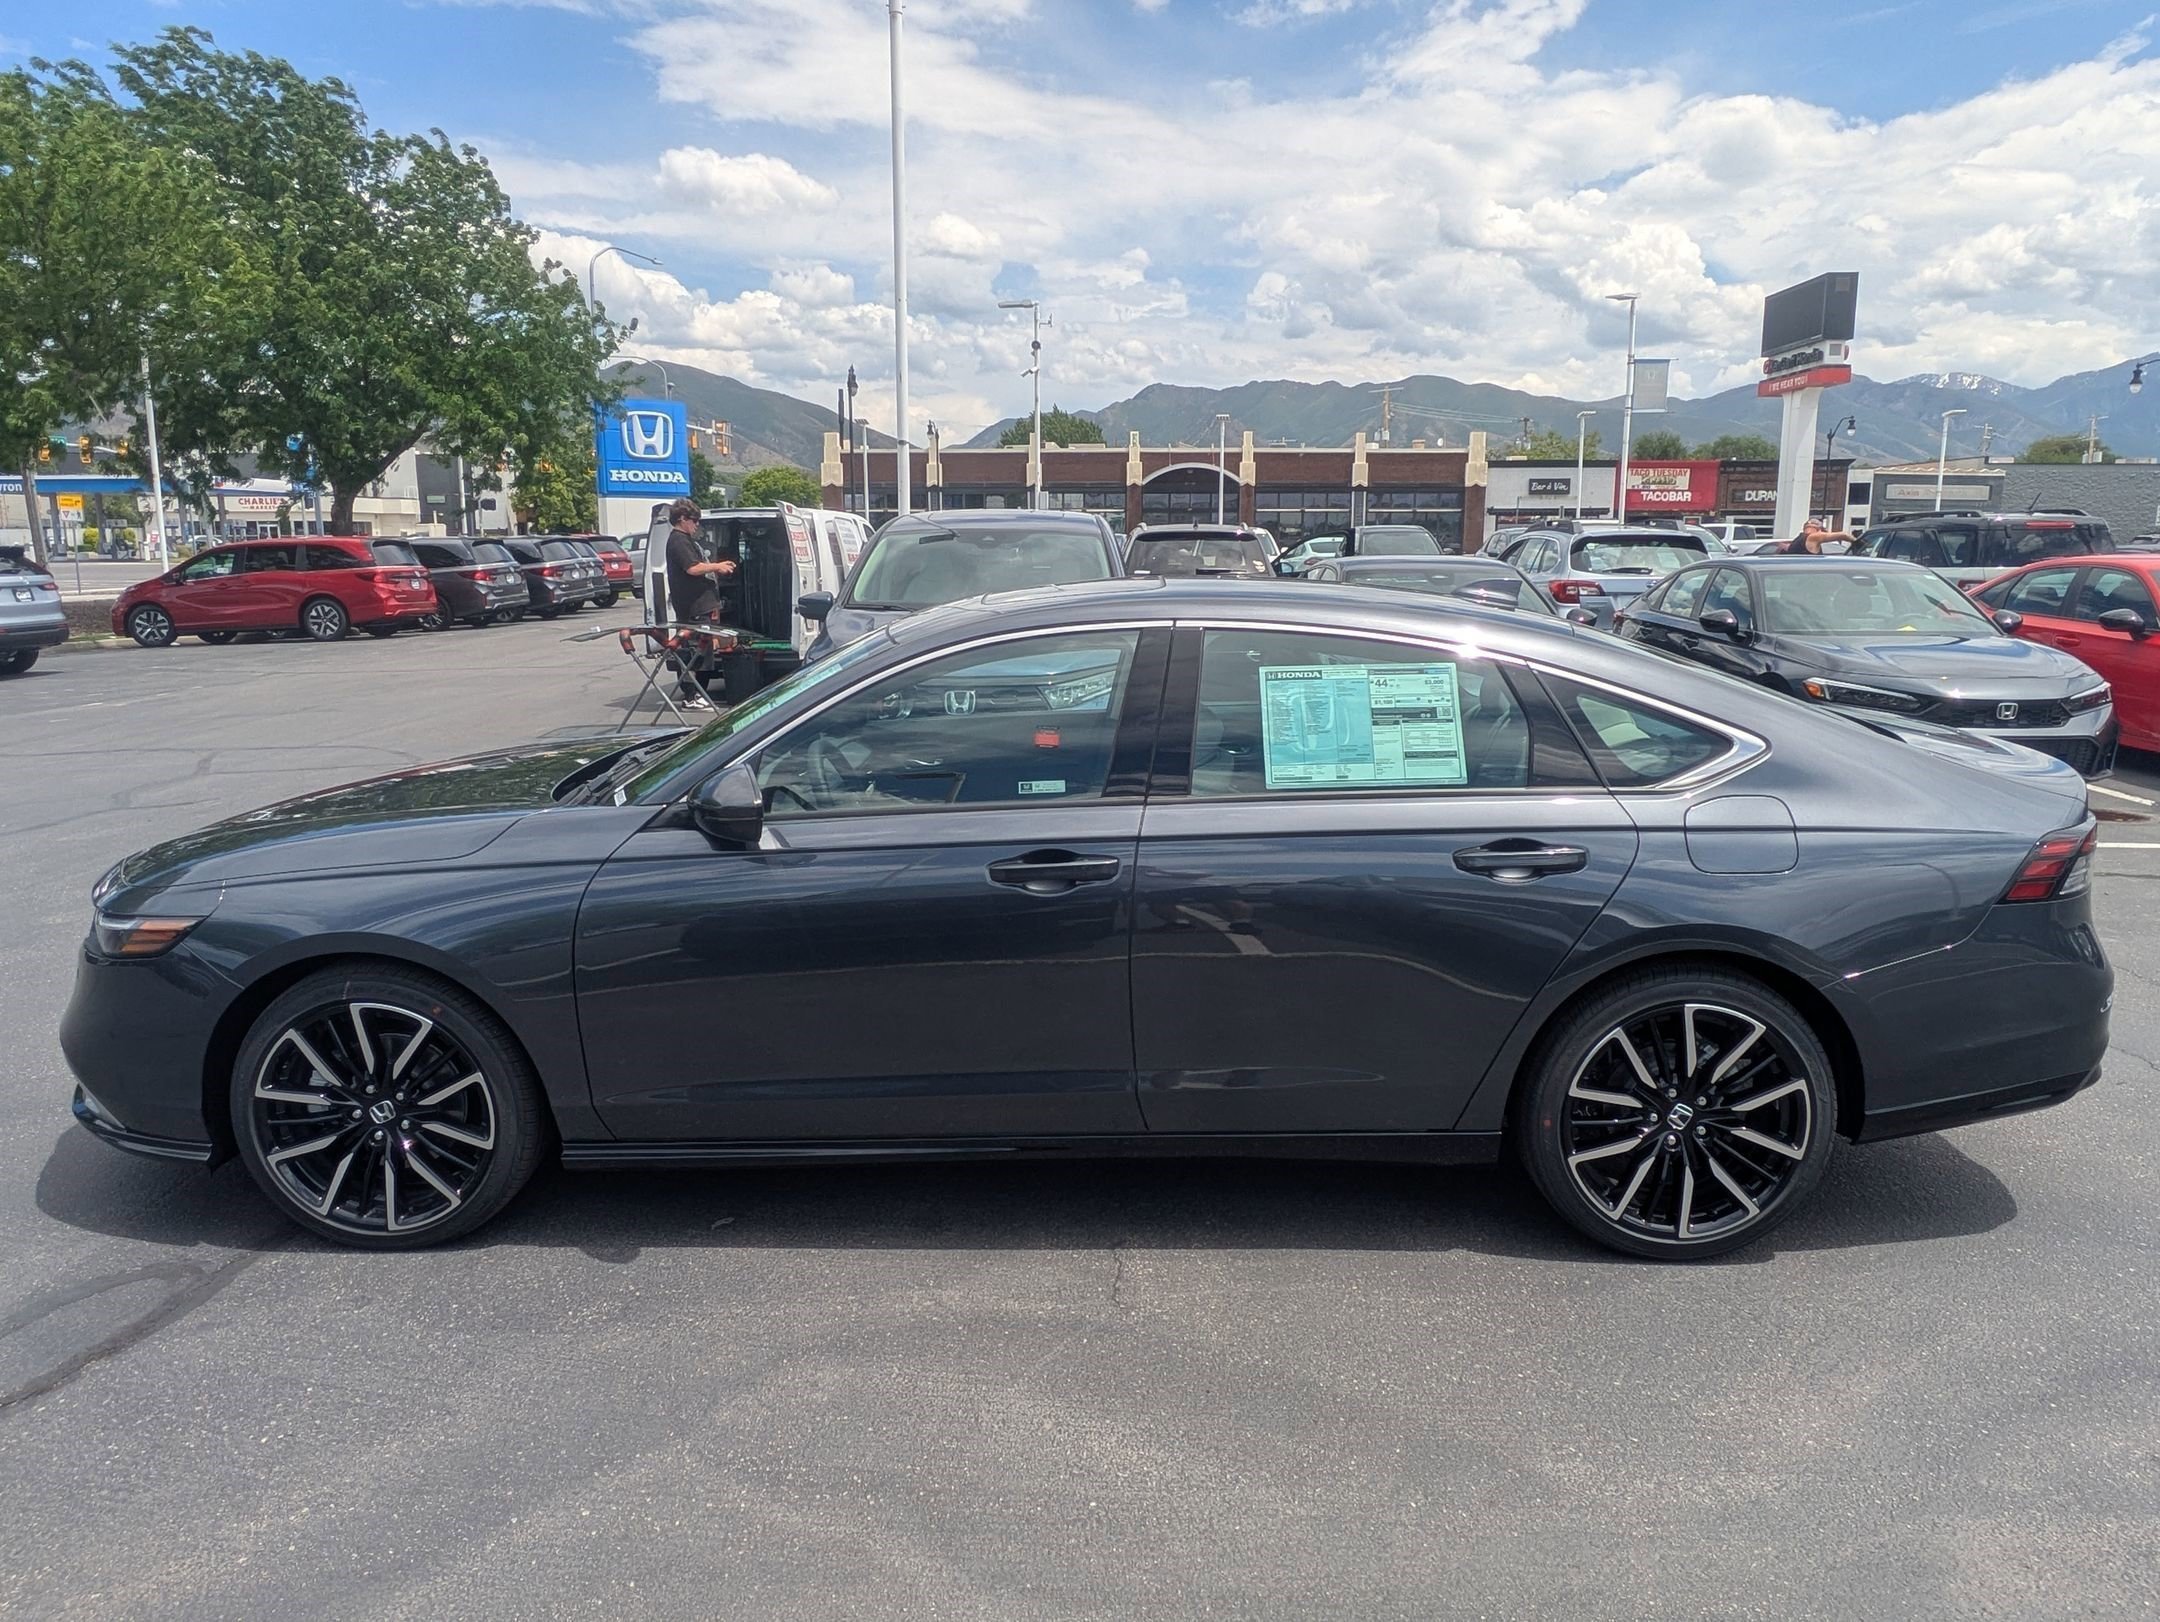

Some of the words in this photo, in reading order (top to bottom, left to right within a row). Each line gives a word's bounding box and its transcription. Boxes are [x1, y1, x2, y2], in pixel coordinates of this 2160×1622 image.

[1780, 377, 1794, 389] HEAR
[609, 469, 687, 483] HONDA
[1630, 469, 1650, 477] TACO
[1652, 469, 1688, 477] TUESDAY
[1640, 491, 1692, 502] TACOBAR
[238, 497, 287, 505] CHARLIE'S
[1277, 671, 1320, 679] HONDA
[1375, 679, 1388, 687] 44
